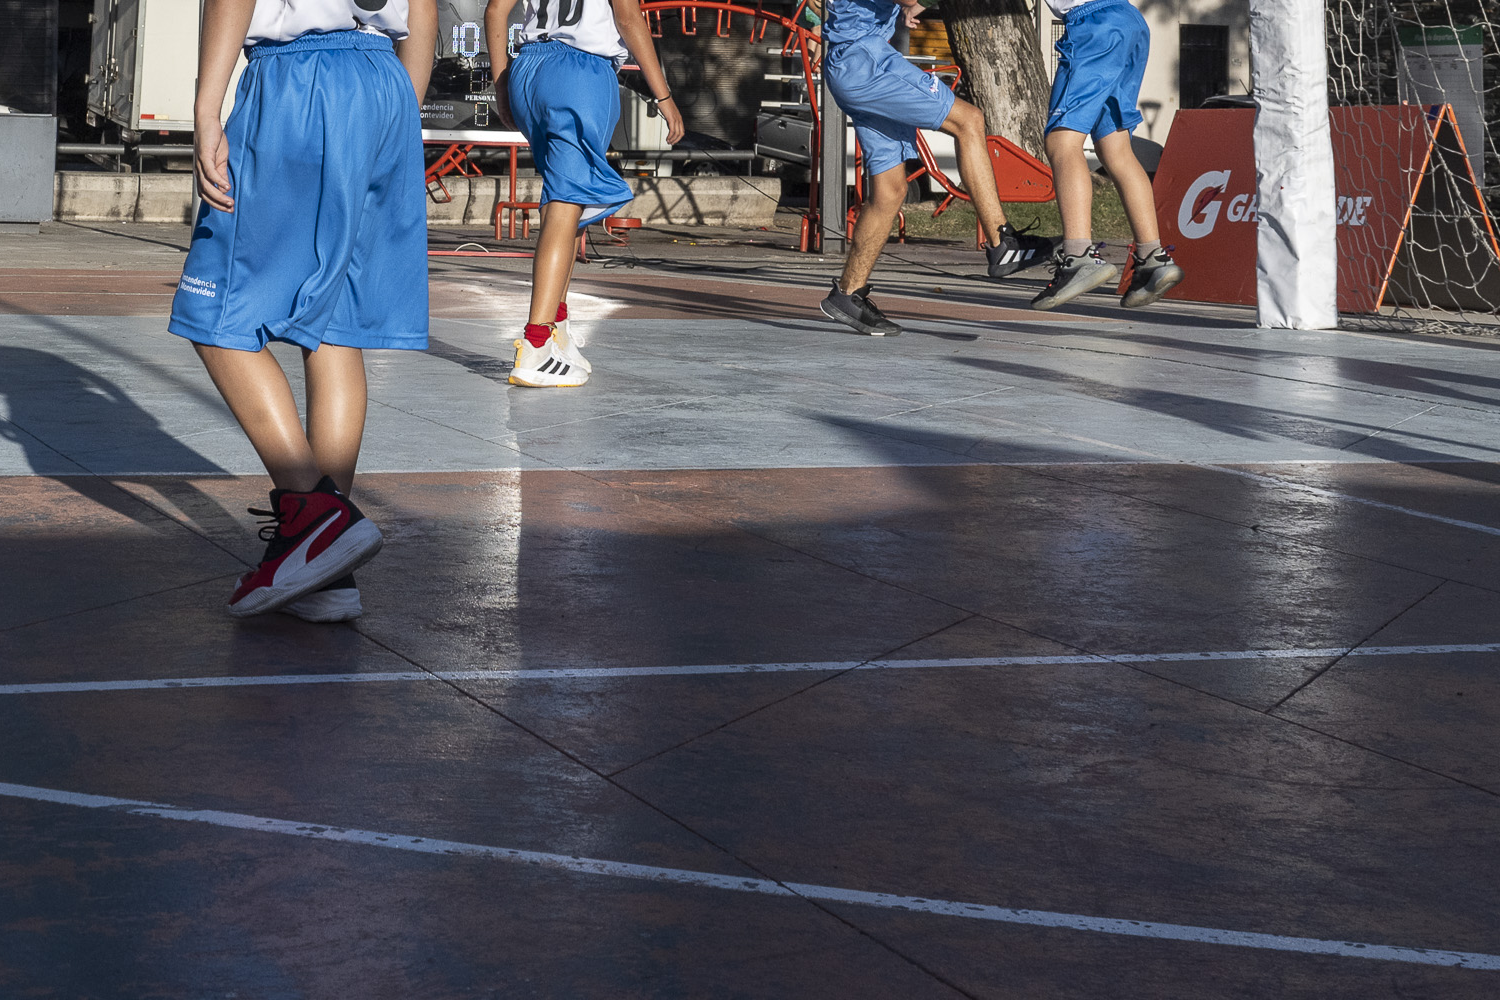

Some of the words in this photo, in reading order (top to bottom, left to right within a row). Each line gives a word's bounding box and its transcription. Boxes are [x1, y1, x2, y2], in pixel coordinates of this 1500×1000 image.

[465, 94, 497, 102] PERSONA
[421, 103, 454, 112] endencia
[419, 111, 454, 120] ontevideo
[182, 273, 217, 290] Intendencia
[180, 281, 216, 298] Montevideo
